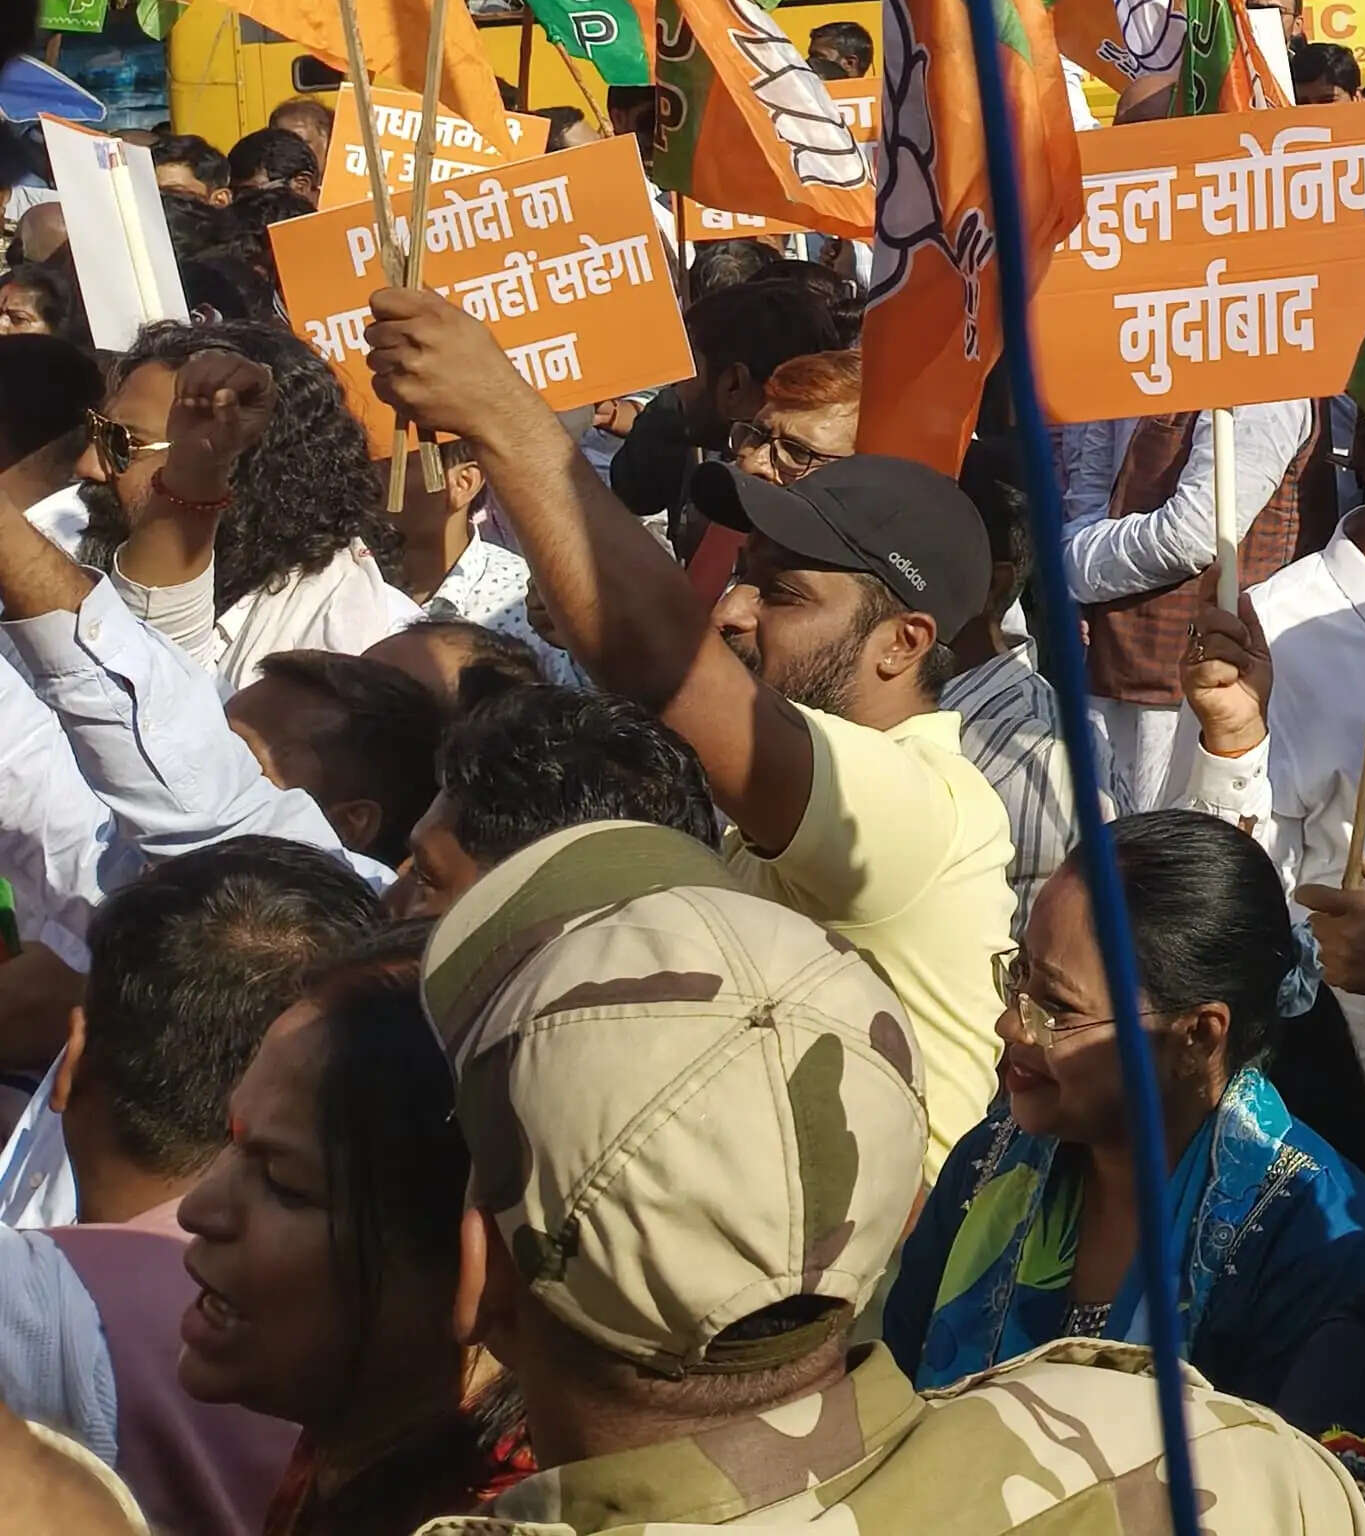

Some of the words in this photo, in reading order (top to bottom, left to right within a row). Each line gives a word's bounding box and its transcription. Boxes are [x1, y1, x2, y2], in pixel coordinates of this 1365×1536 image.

[424, 175, 514, 253] मोदी
[514, 175, 573, 230] का
[454, 251, 539, 324] नहीं
[539, 234, 654, 305] सहेगा
[1113, 259, 1319, 395] मुर्दाबाद
[888, 551, 927, 591] adidas
